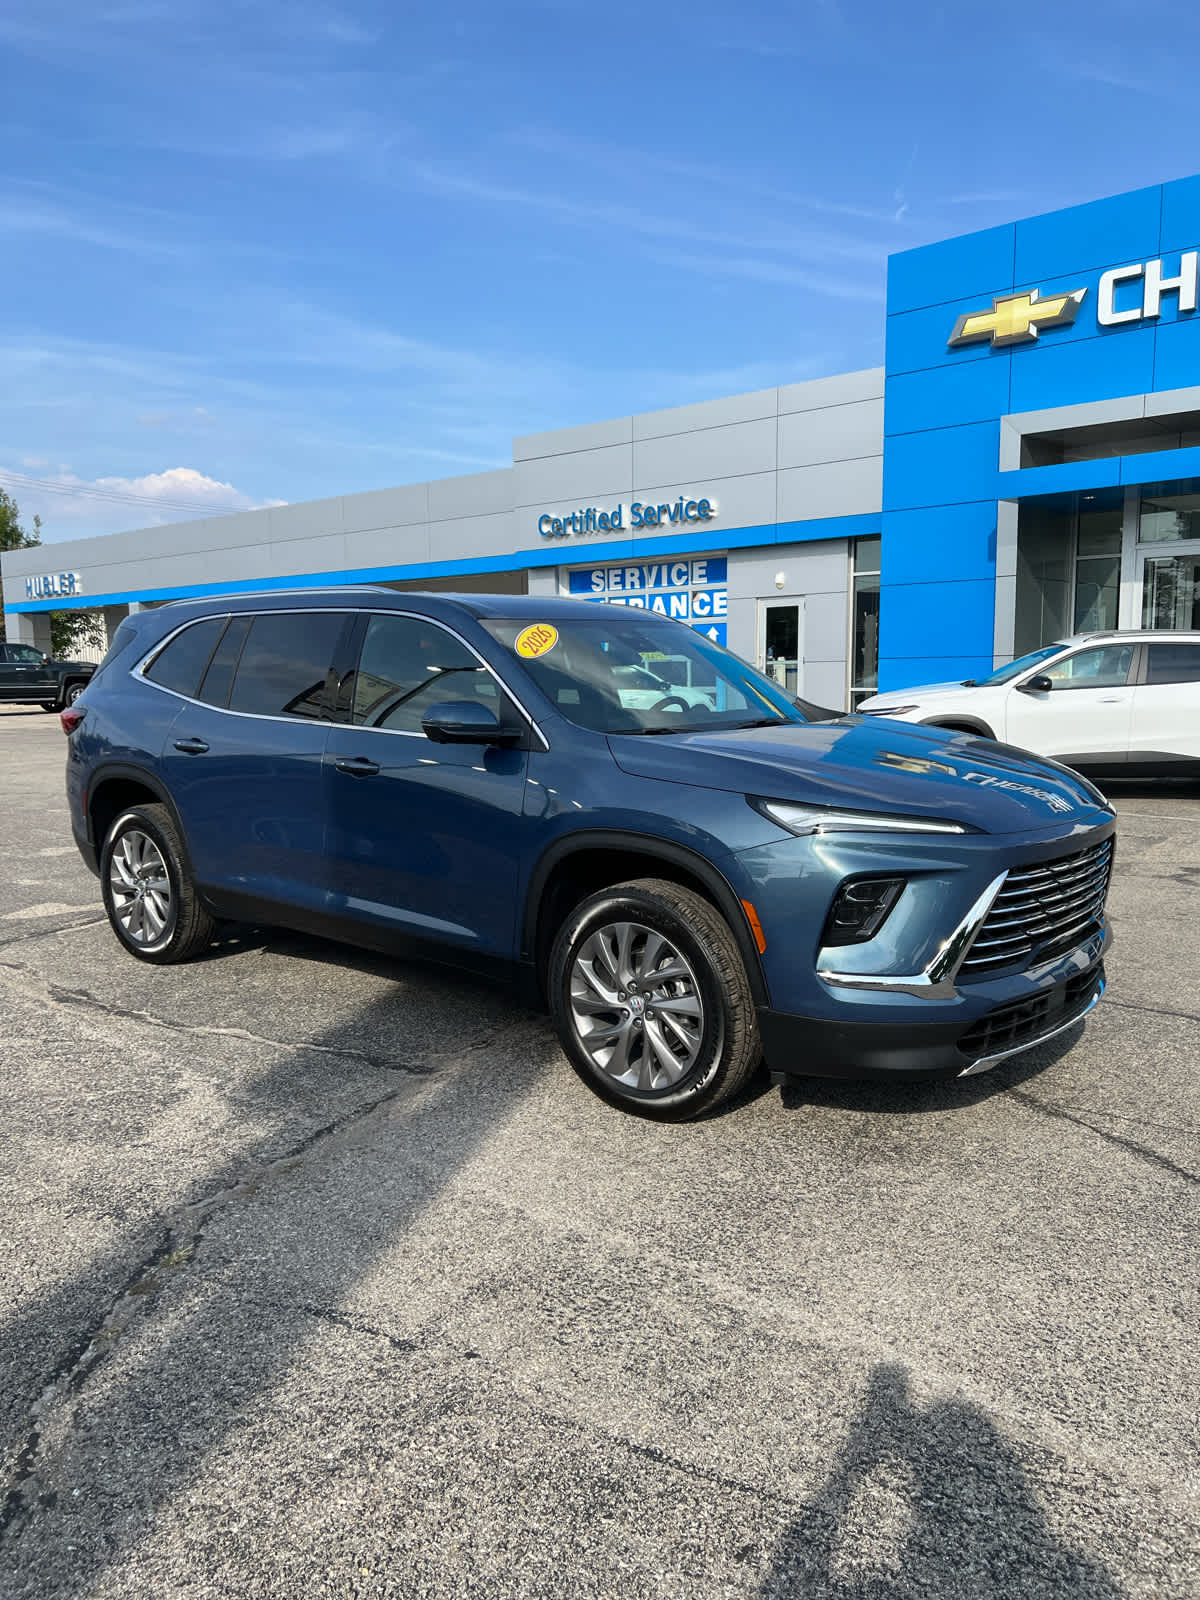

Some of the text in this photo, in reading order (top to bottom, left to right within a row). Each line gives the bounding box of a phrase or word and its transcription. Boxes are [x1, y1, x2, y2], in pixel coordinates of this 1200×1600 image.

[1098, 251, 1198, 326] CH
[538, 496, 711, 536] Certified Service
[25, 573, 77, 597] HUBLER
[591, 561, 708, 592] SERVICE
[522, 626, 552, 654] 2026
